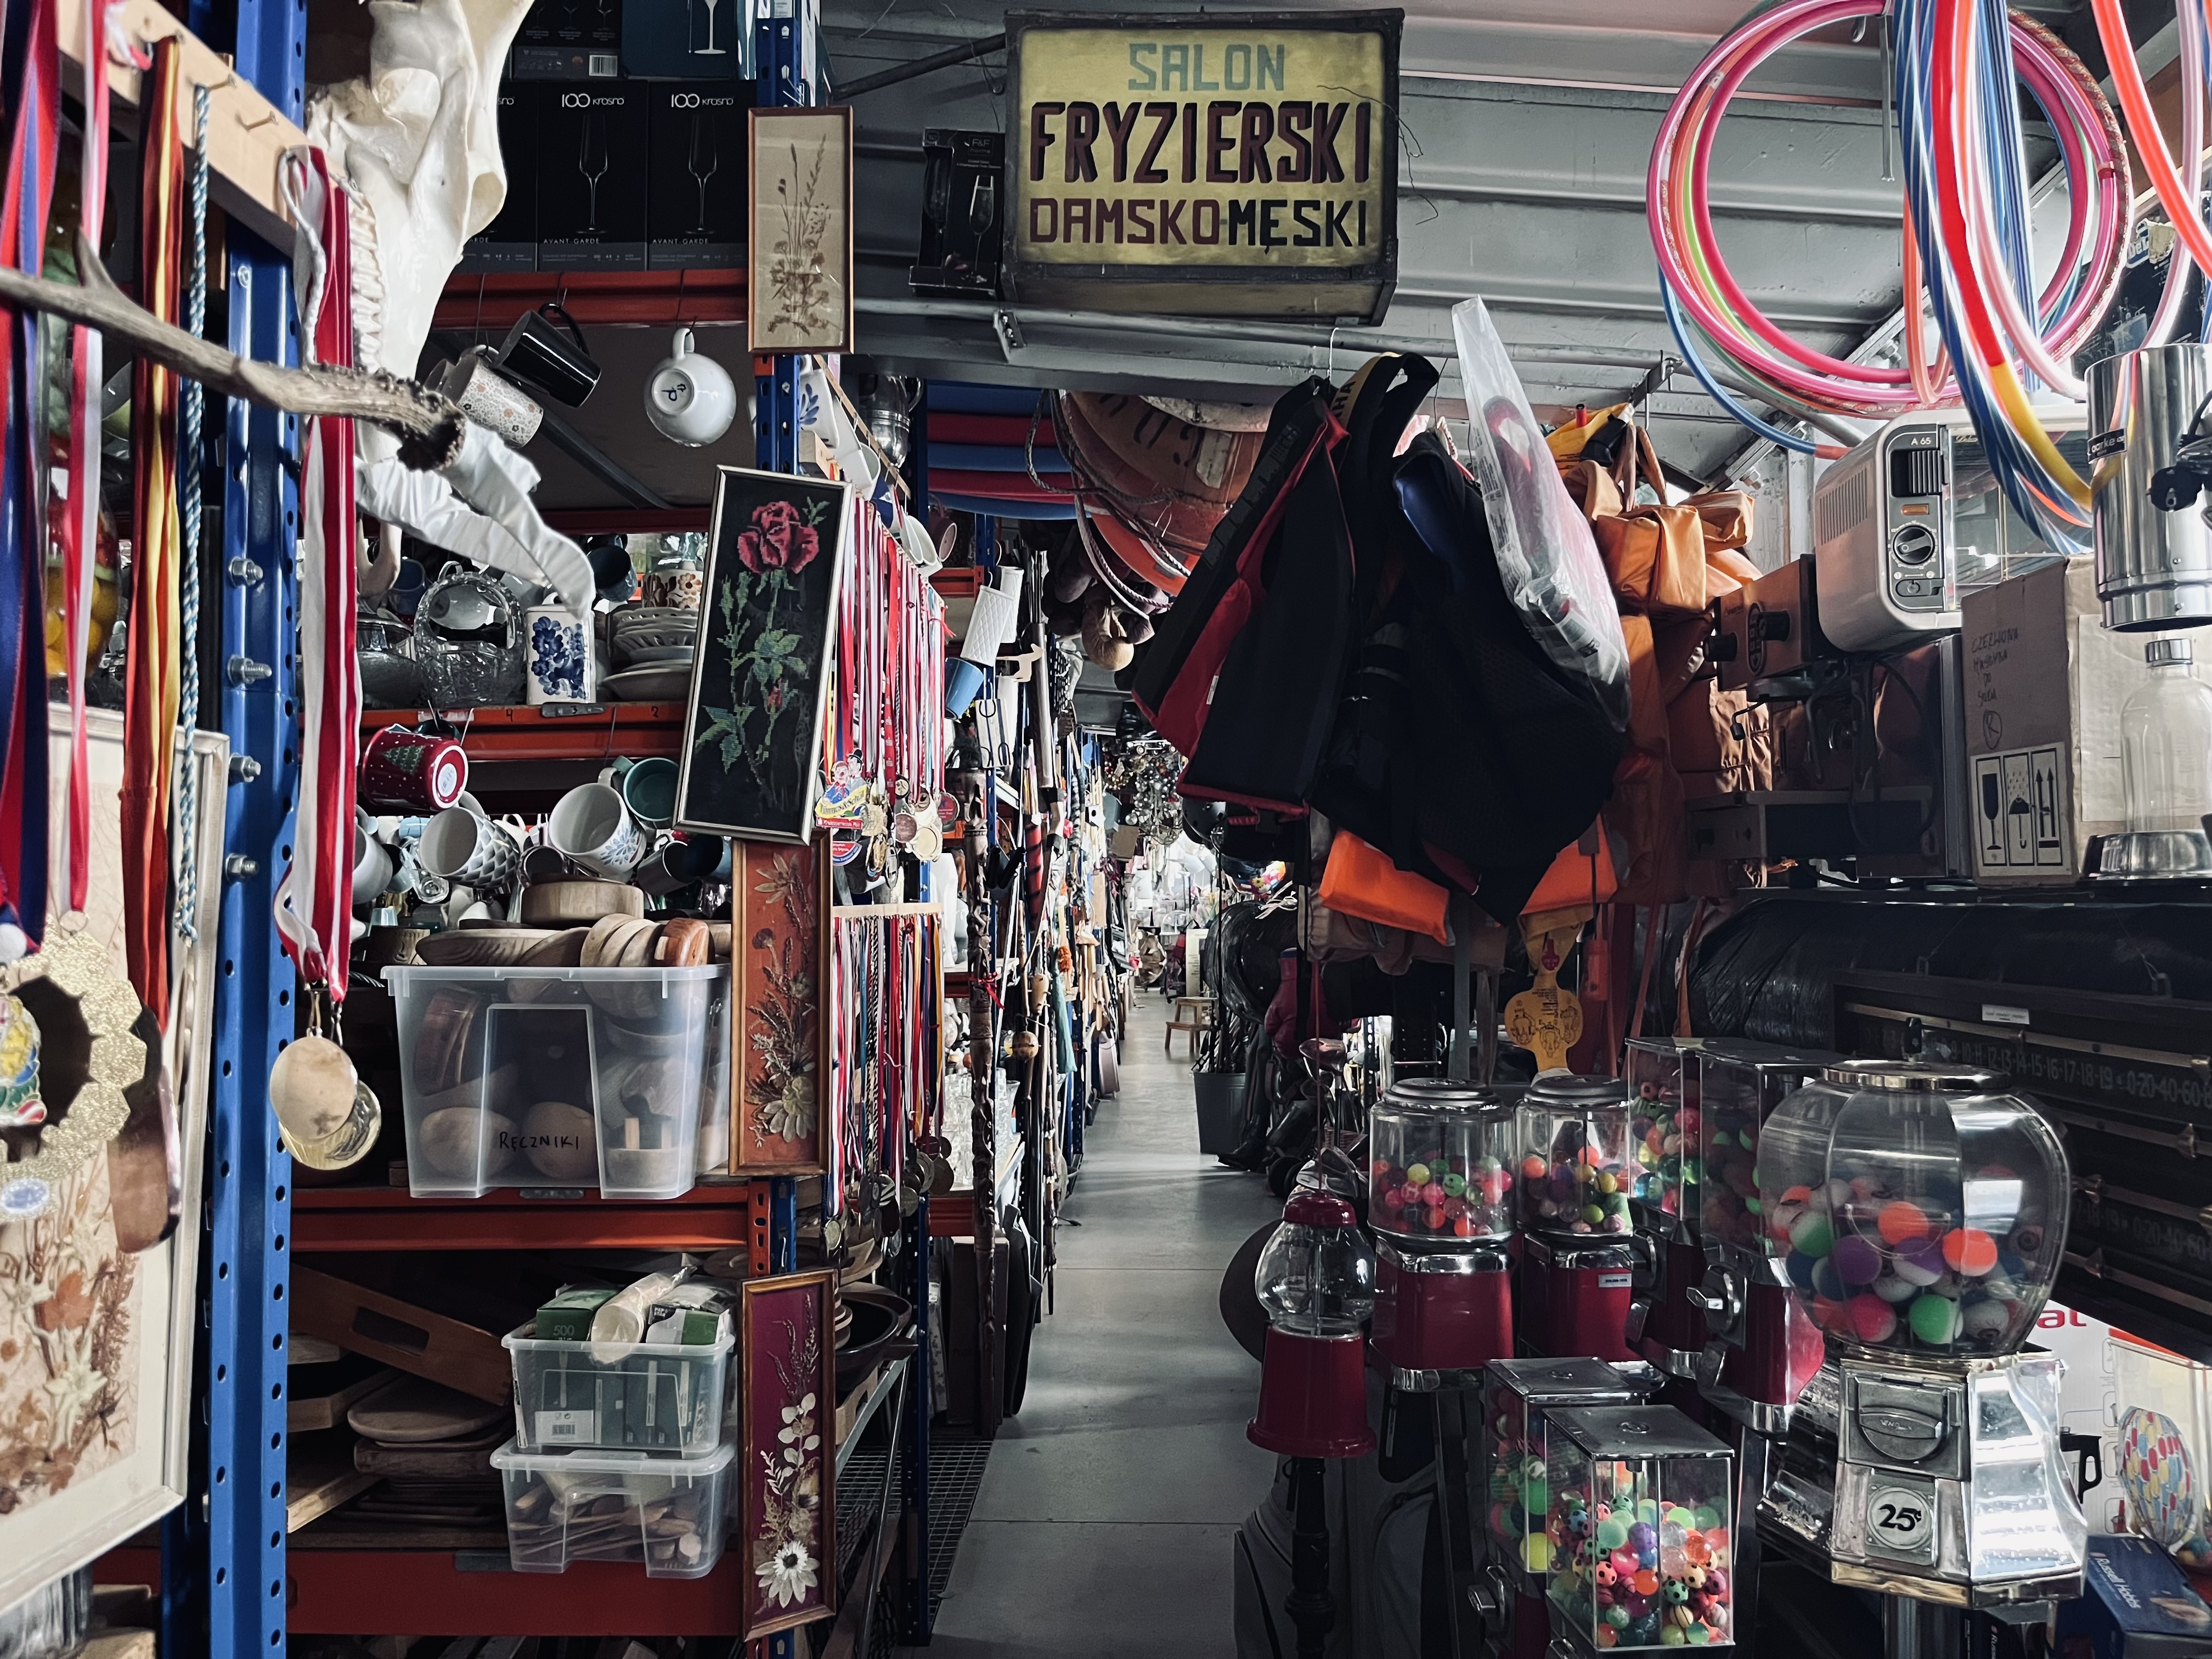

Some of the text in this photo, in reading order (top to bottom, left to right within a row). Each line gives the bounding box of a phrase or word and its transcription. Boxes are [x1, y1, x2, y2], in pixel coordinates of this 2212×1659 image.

[1128, 43, 1285, 91] SALON
[562, 93, 590, 108] 100
[672, 93, 700, 108] 100
[1030, 101, 1371, 183] FRYZIERSKI
[506, 709, 513, 723] 4
[651, 706, 659, 718] 2
[500, 1131, 578, 1152] RĘCZNIKI
[553, 1325, 575, 1336] 500
[2094, 1558, 2142, 1609] Russell Hobbs
